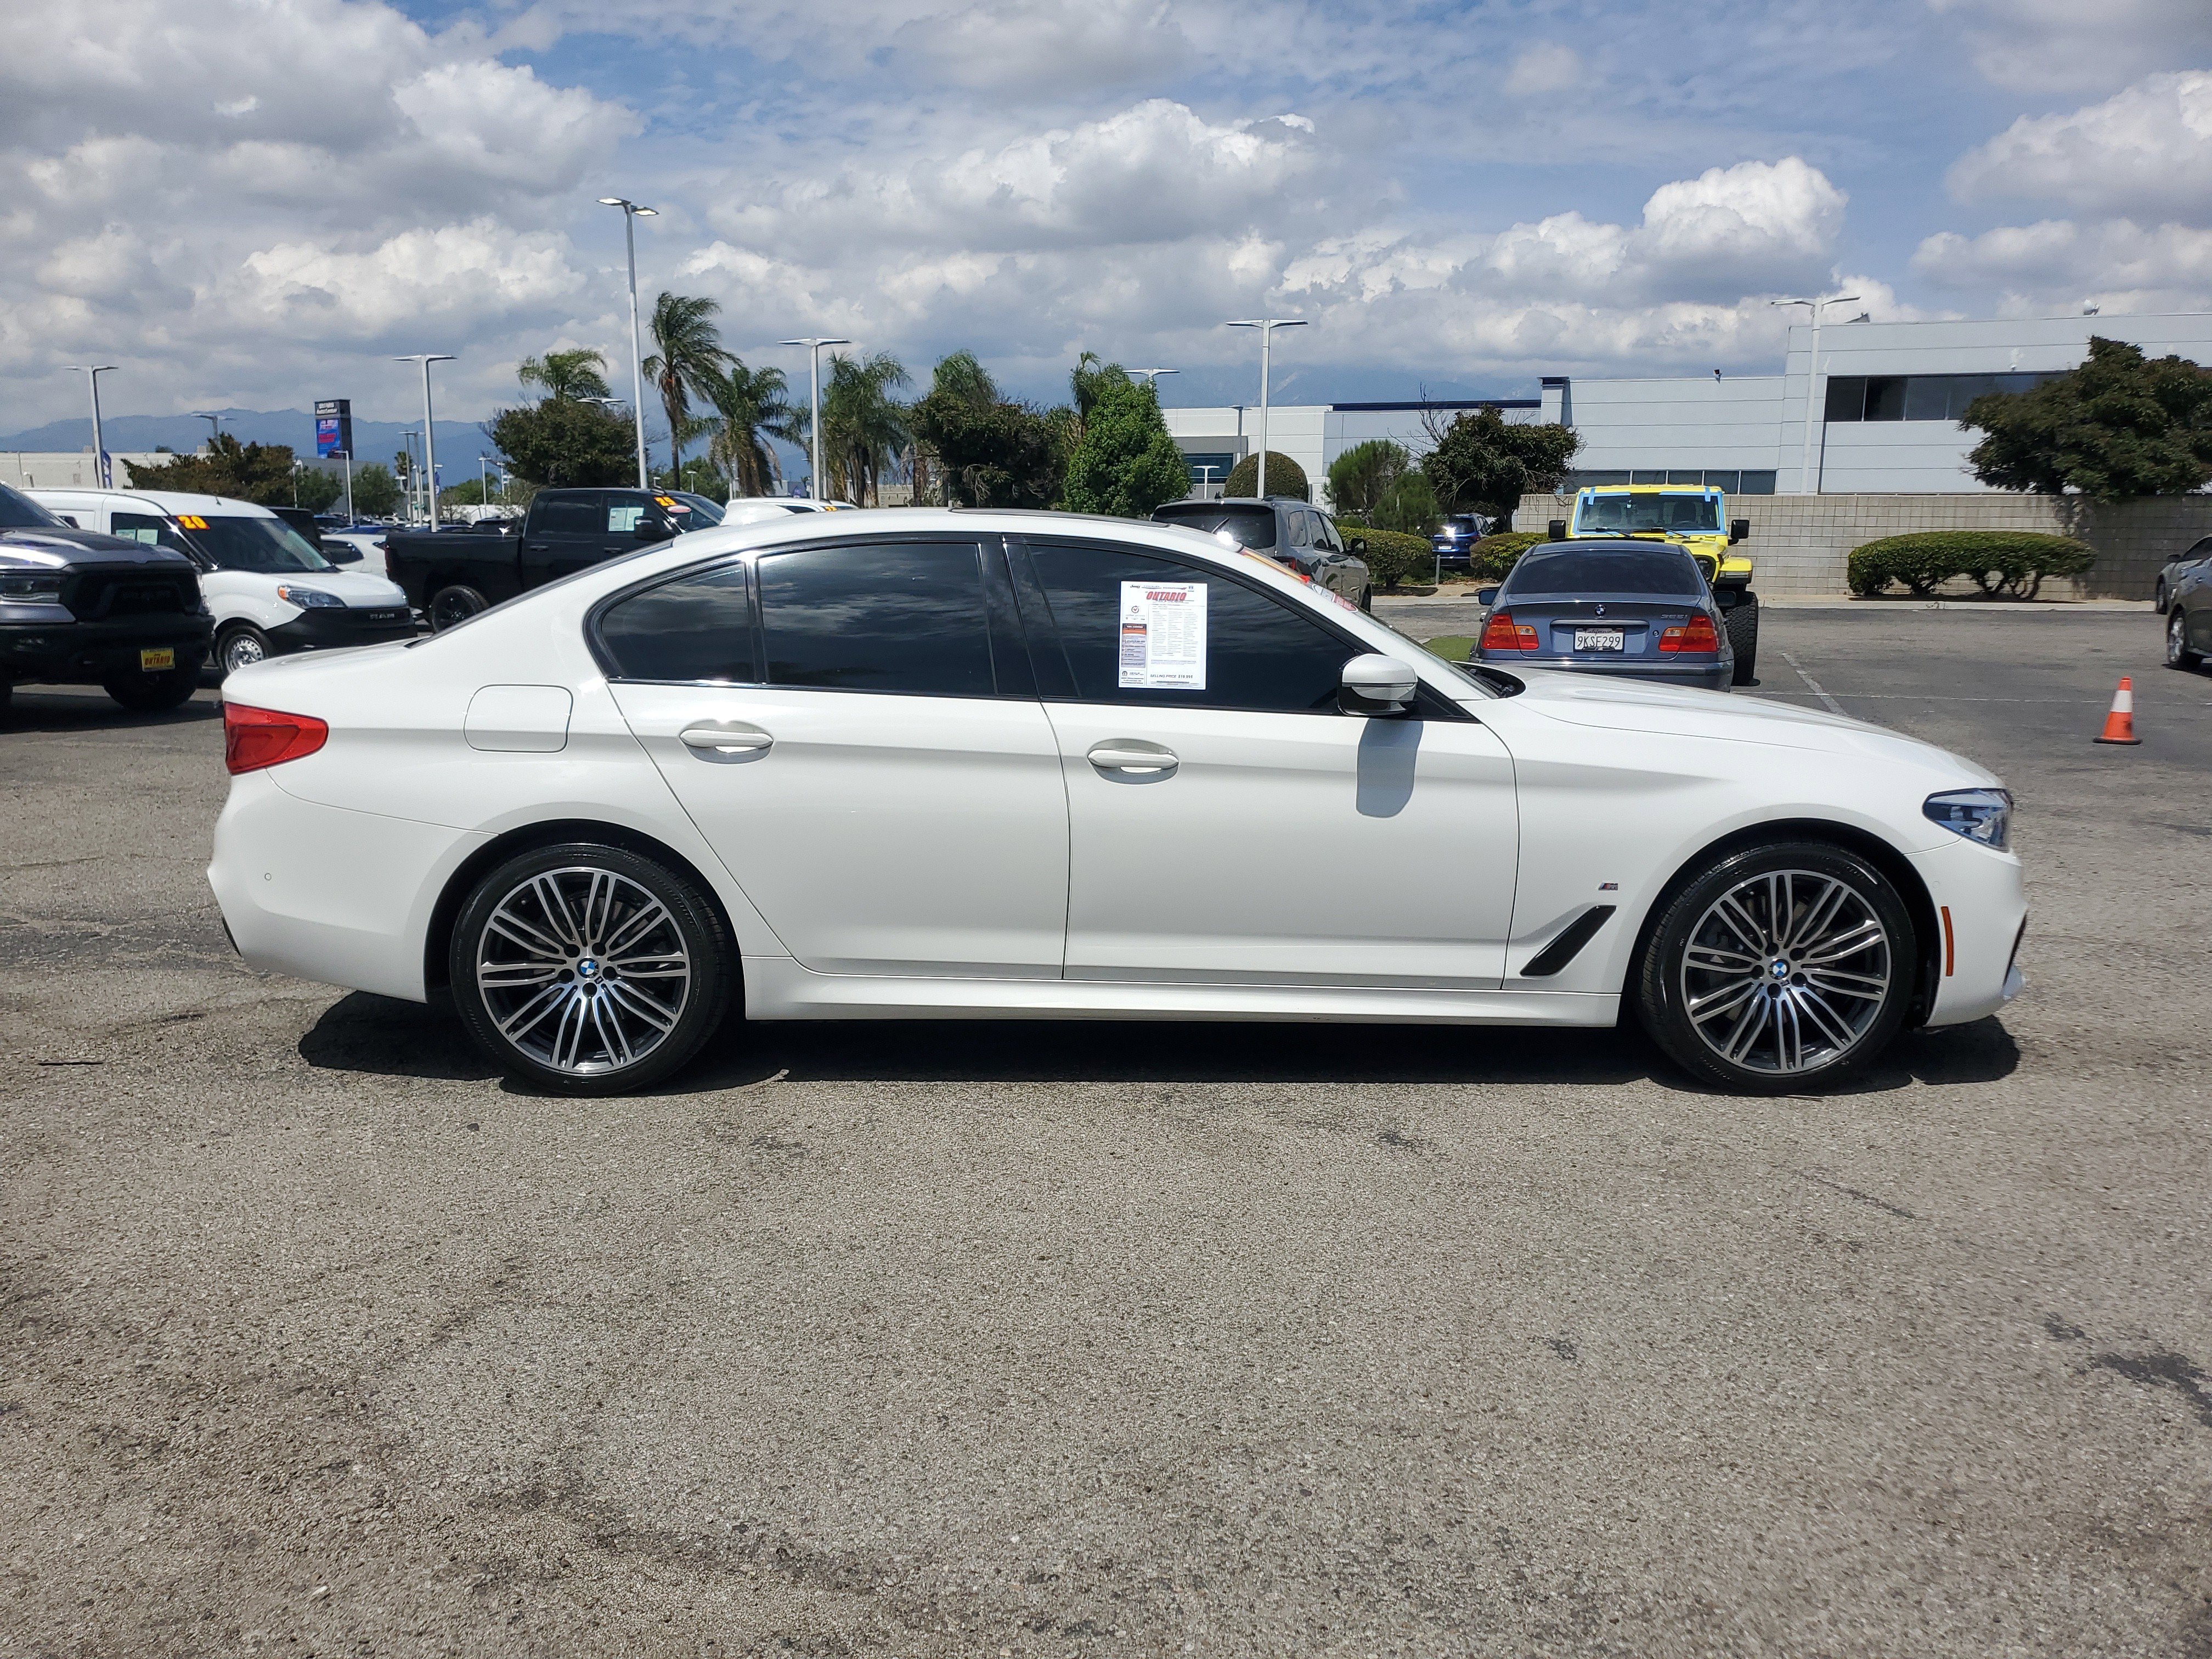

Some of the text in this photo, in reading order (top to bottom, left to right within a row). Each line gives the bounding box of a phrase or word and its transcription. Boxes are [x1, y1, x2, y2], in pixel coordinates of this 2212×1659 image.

[178, 516, 207, 529] 20
[1146, 591, 1187, 601] ONTARIO
[144, 655, 171, 665] ONTARIO
